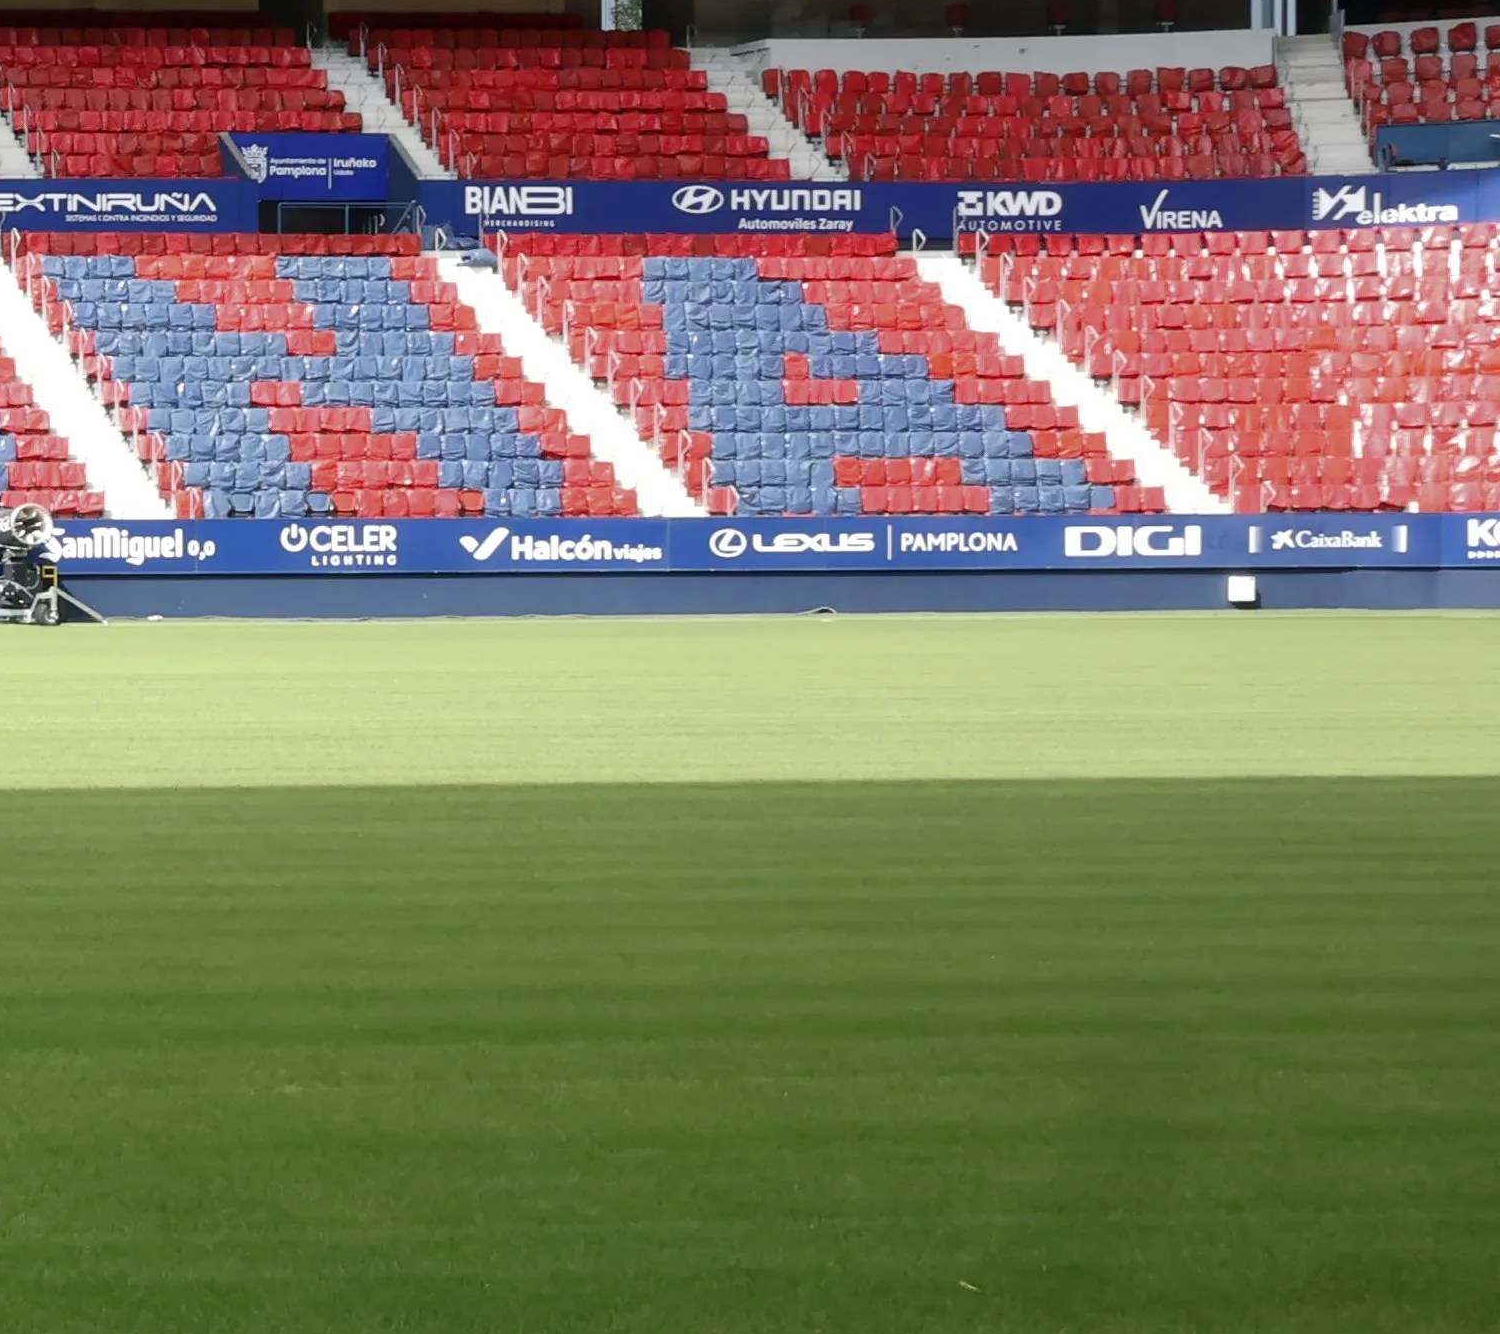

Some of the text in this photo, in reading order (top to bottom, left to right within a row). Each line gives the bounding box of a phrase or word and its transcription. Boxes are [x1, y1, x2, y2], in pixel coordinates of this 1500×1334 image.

[270, 165, 326, 176] Pamplona
[334, 157, 376, 168] Iruñeko
[731, 190, 861, 211] HYUNDAI
[987, 191, 1061, 215] KWD
[1141, 189, 1223, 229] VIRENA
[1356, 192, 1458, 224] elektra
[738, 218, 853, 232] Automoviles Zaray
[957, 220, 1062, 231] AUTOMOTIVE
[309, 525, 397, 551] CELER
[753, 532, 1017, 551] LEXUS PAMPLONA
[1065, 525, 1201, 556] DIGI
[1296, 532, 1382, 548] CaixaBank
[187, 540, 215, 559] 0,0
[512, 535, 662, 562] Halcón viajes
[311, 555, 397, 565] LIGHTING
